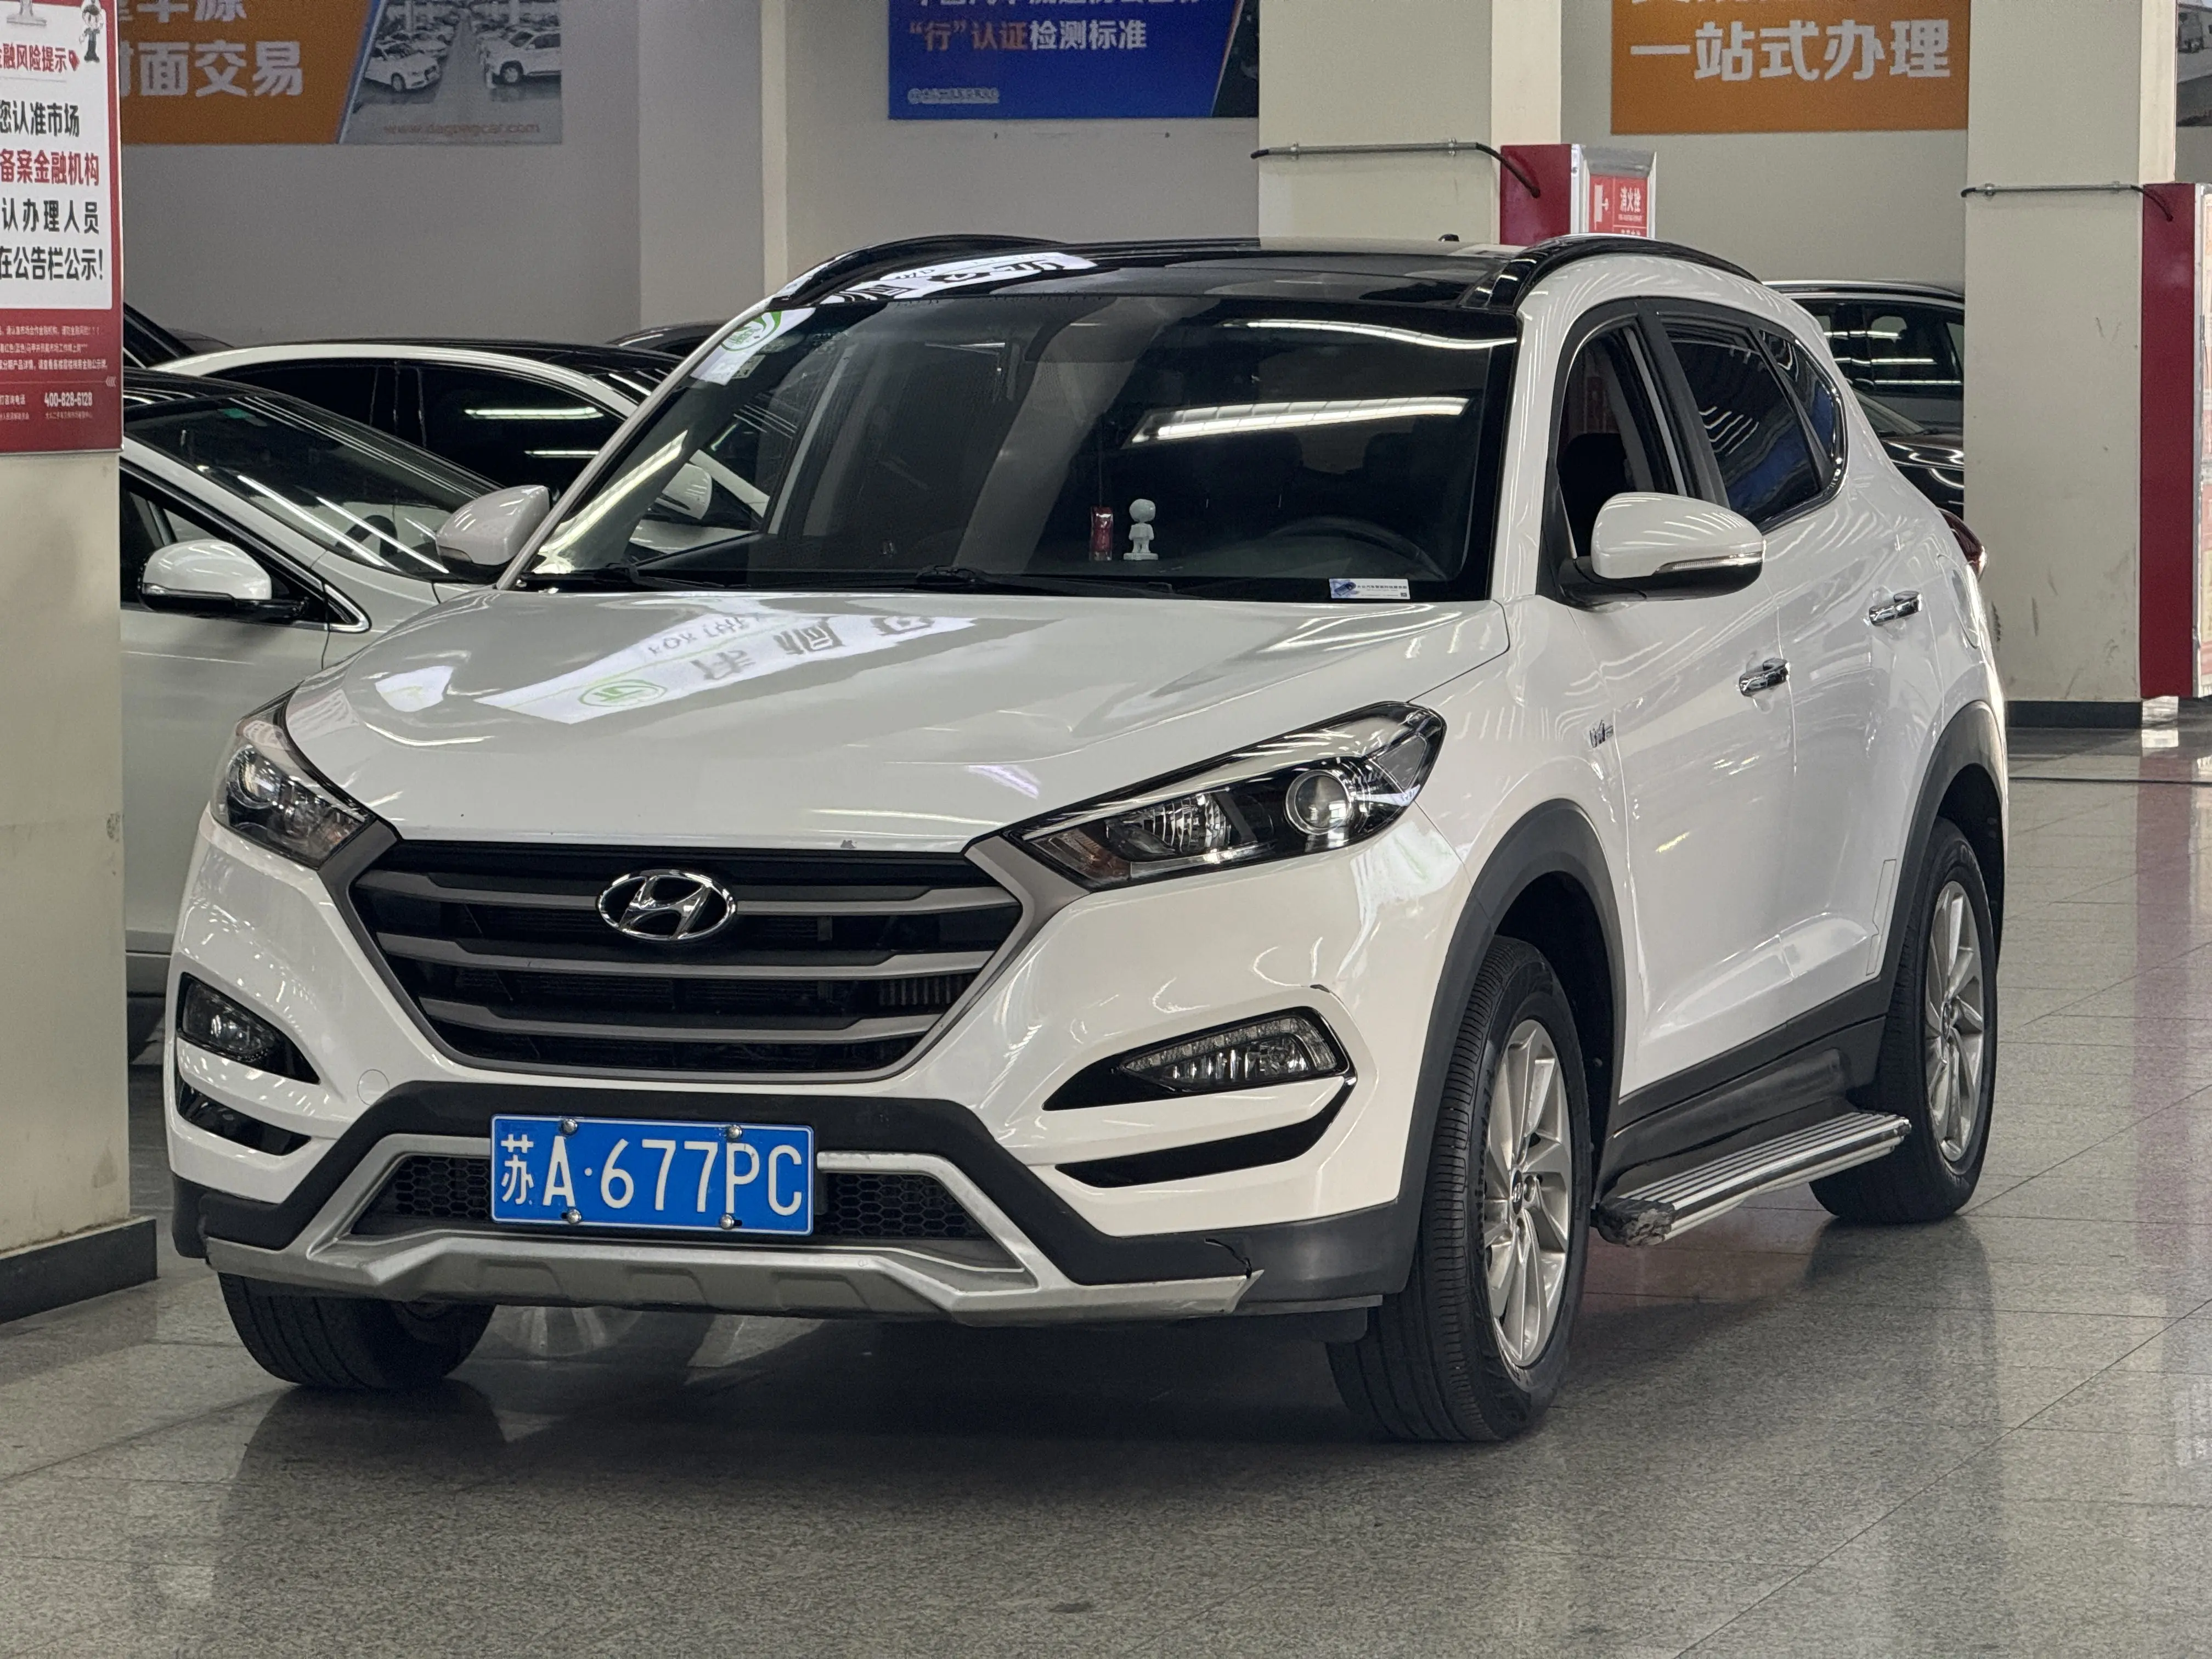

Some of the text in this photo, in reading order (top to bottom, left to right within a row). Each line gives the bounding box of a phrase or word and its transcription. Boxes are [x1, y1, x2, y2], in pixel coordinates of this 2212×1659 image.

[0, 42, 67, 74] 融风险提示
[119, 40, 303, 98] 面交易
[1630, 19, 1950, 81] 一站式办理
[0, 149, 99, 187] 备案金融机构
[2, 197, 99, 234] 认办理人员
[501, 1133, 803, 1216] 苏A·677PC
